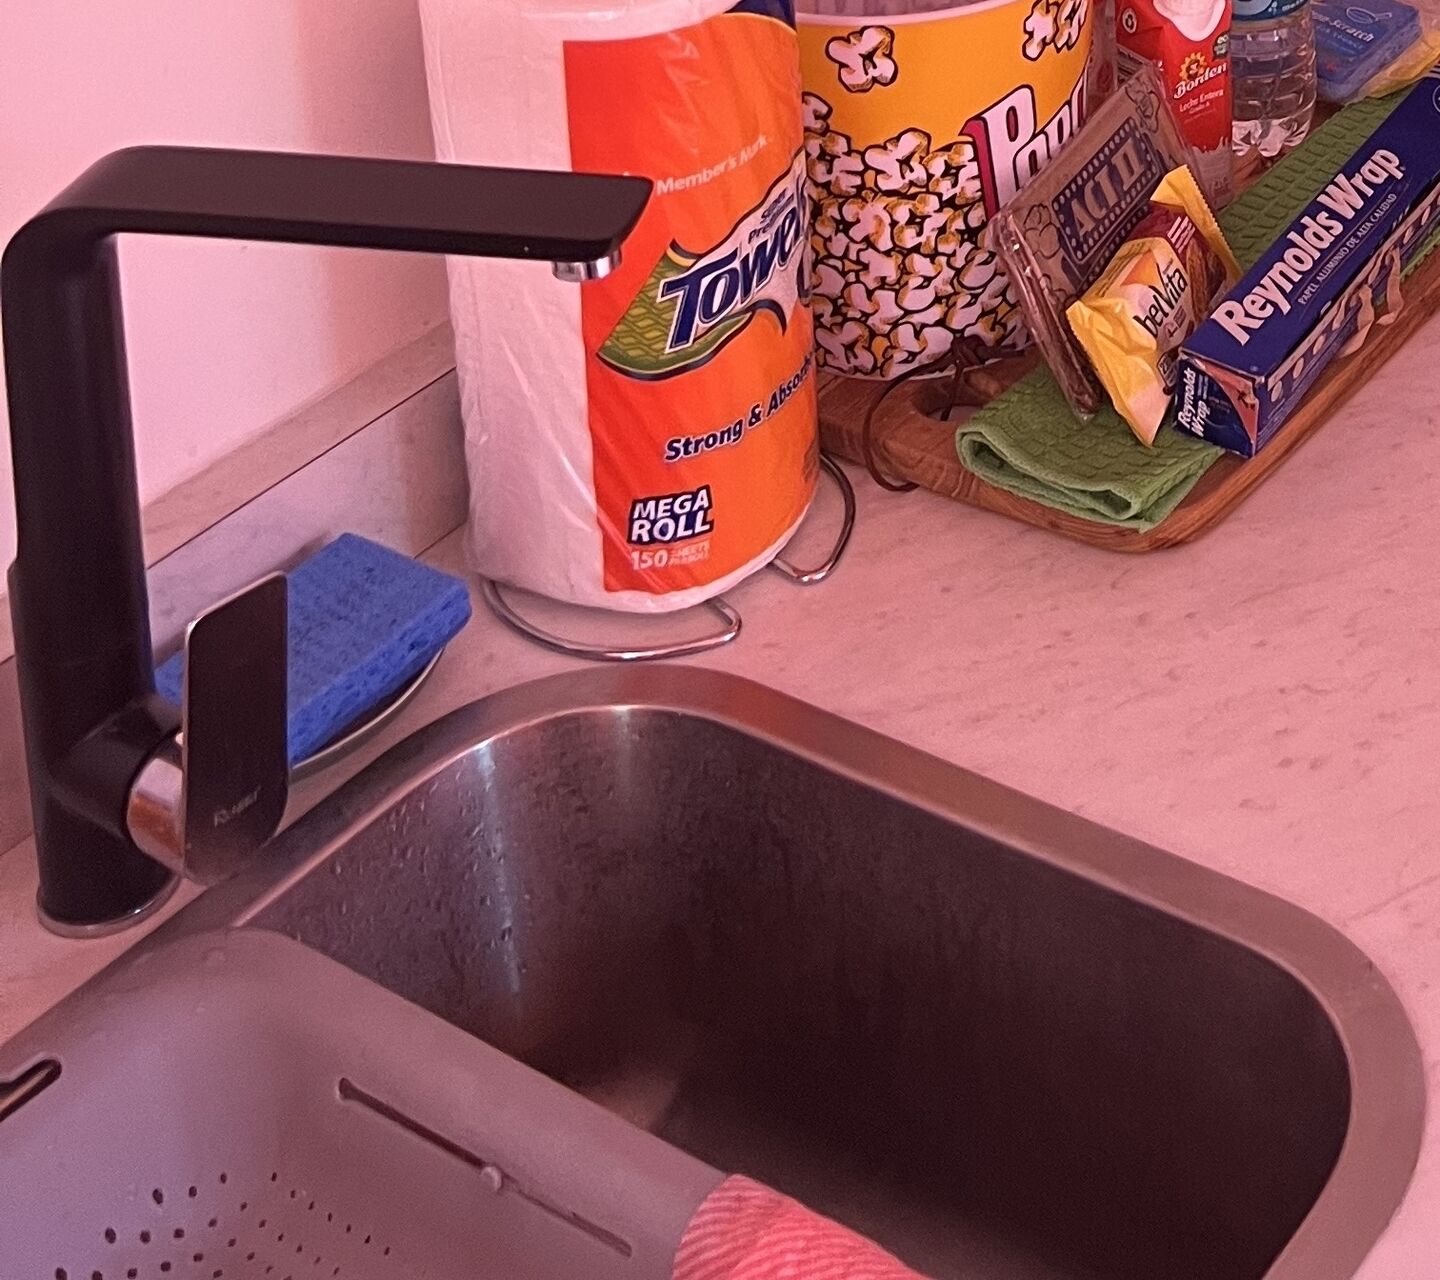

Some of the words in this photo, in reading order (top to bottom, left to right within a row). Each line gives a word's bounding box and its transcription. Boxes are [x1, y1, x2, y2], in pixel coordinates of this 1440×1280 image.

[1174, 62, 1228, 99] Borden
[656, 157, 737, 196] Member's
[1071, 164, 1119, 239] ACT
[1210, 215, 1344, 346] Reynolds
[1316, 149, 1404, 220] Wrap
[1297, 282, 1319, 305] PAPEL
[1318, 247, 1350, 283] ALUMINIO
[1348, 238, 1361, 253] DE
[1356, 221, 1373, 240] ALTA
[1370, 193, 1397, 225] CALIDAD
[1132, 263, 1189, 338] belVita
[1178, 367, 1196, 429] Reynolds
[1191, 399, 1211, 437] Wrap
[664, 418, 744, 462] Strong
[748, 402, 764, 429] &
[632, 509, 710, 542] ROLL
[633, 489, 709, 520] MEGA
[631, 549, 668, 570] 150
